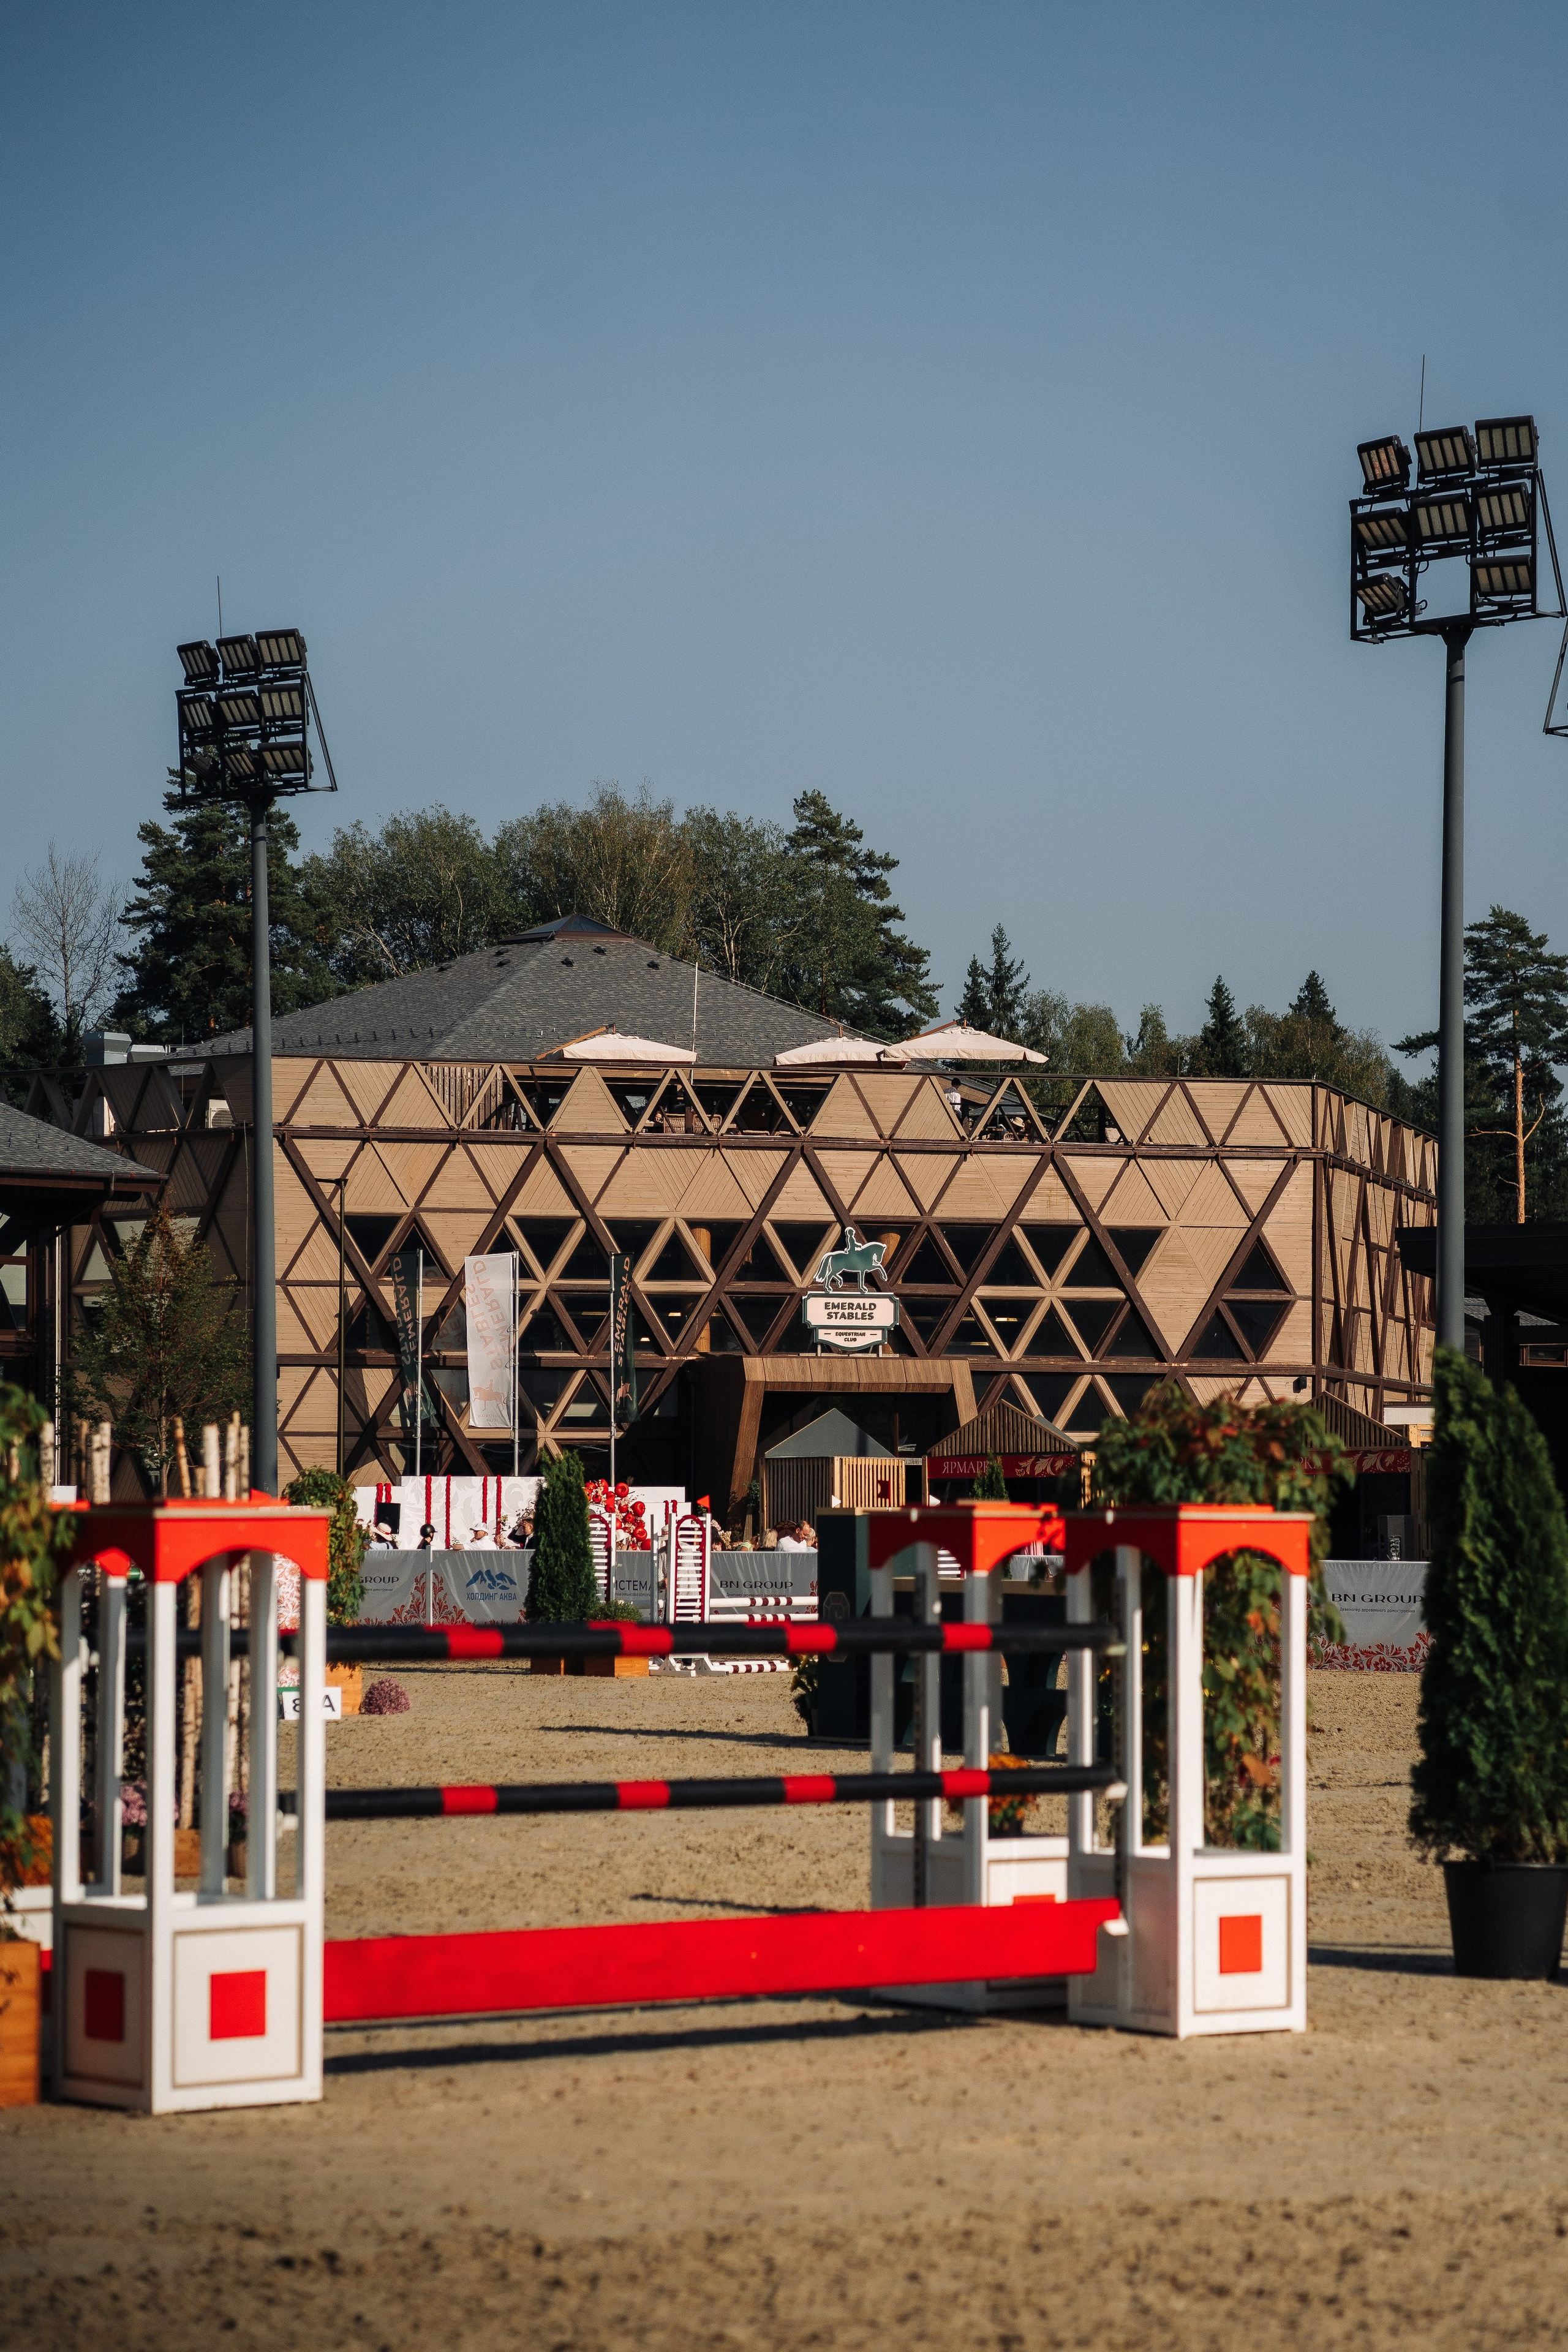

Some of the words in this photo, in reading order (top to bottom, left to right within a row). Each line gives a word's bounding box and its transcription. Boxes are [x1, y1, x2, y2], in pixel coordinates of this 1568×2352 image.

[614, 1257, 630, 1353] EMERALD
[824, 1302, 877, 1311] EMERALD
[827, 1311, 874, 1321] STABLES
[617, 1280, 633, 1368] STABLES
[942, 1461, 989, 1474] ЯРМАРК
[614, 1580, 650, 1591] ИСТЕМ
[743, 1581, 793, 1589] GROUP
[466, 1593, 497, 1602] ХОЛДИНГ
[1332, 1594, 1356, 1602] BN
[1361, 1594, 1425, 1604] GROUP
[322, 1694, 336, 1713] A
